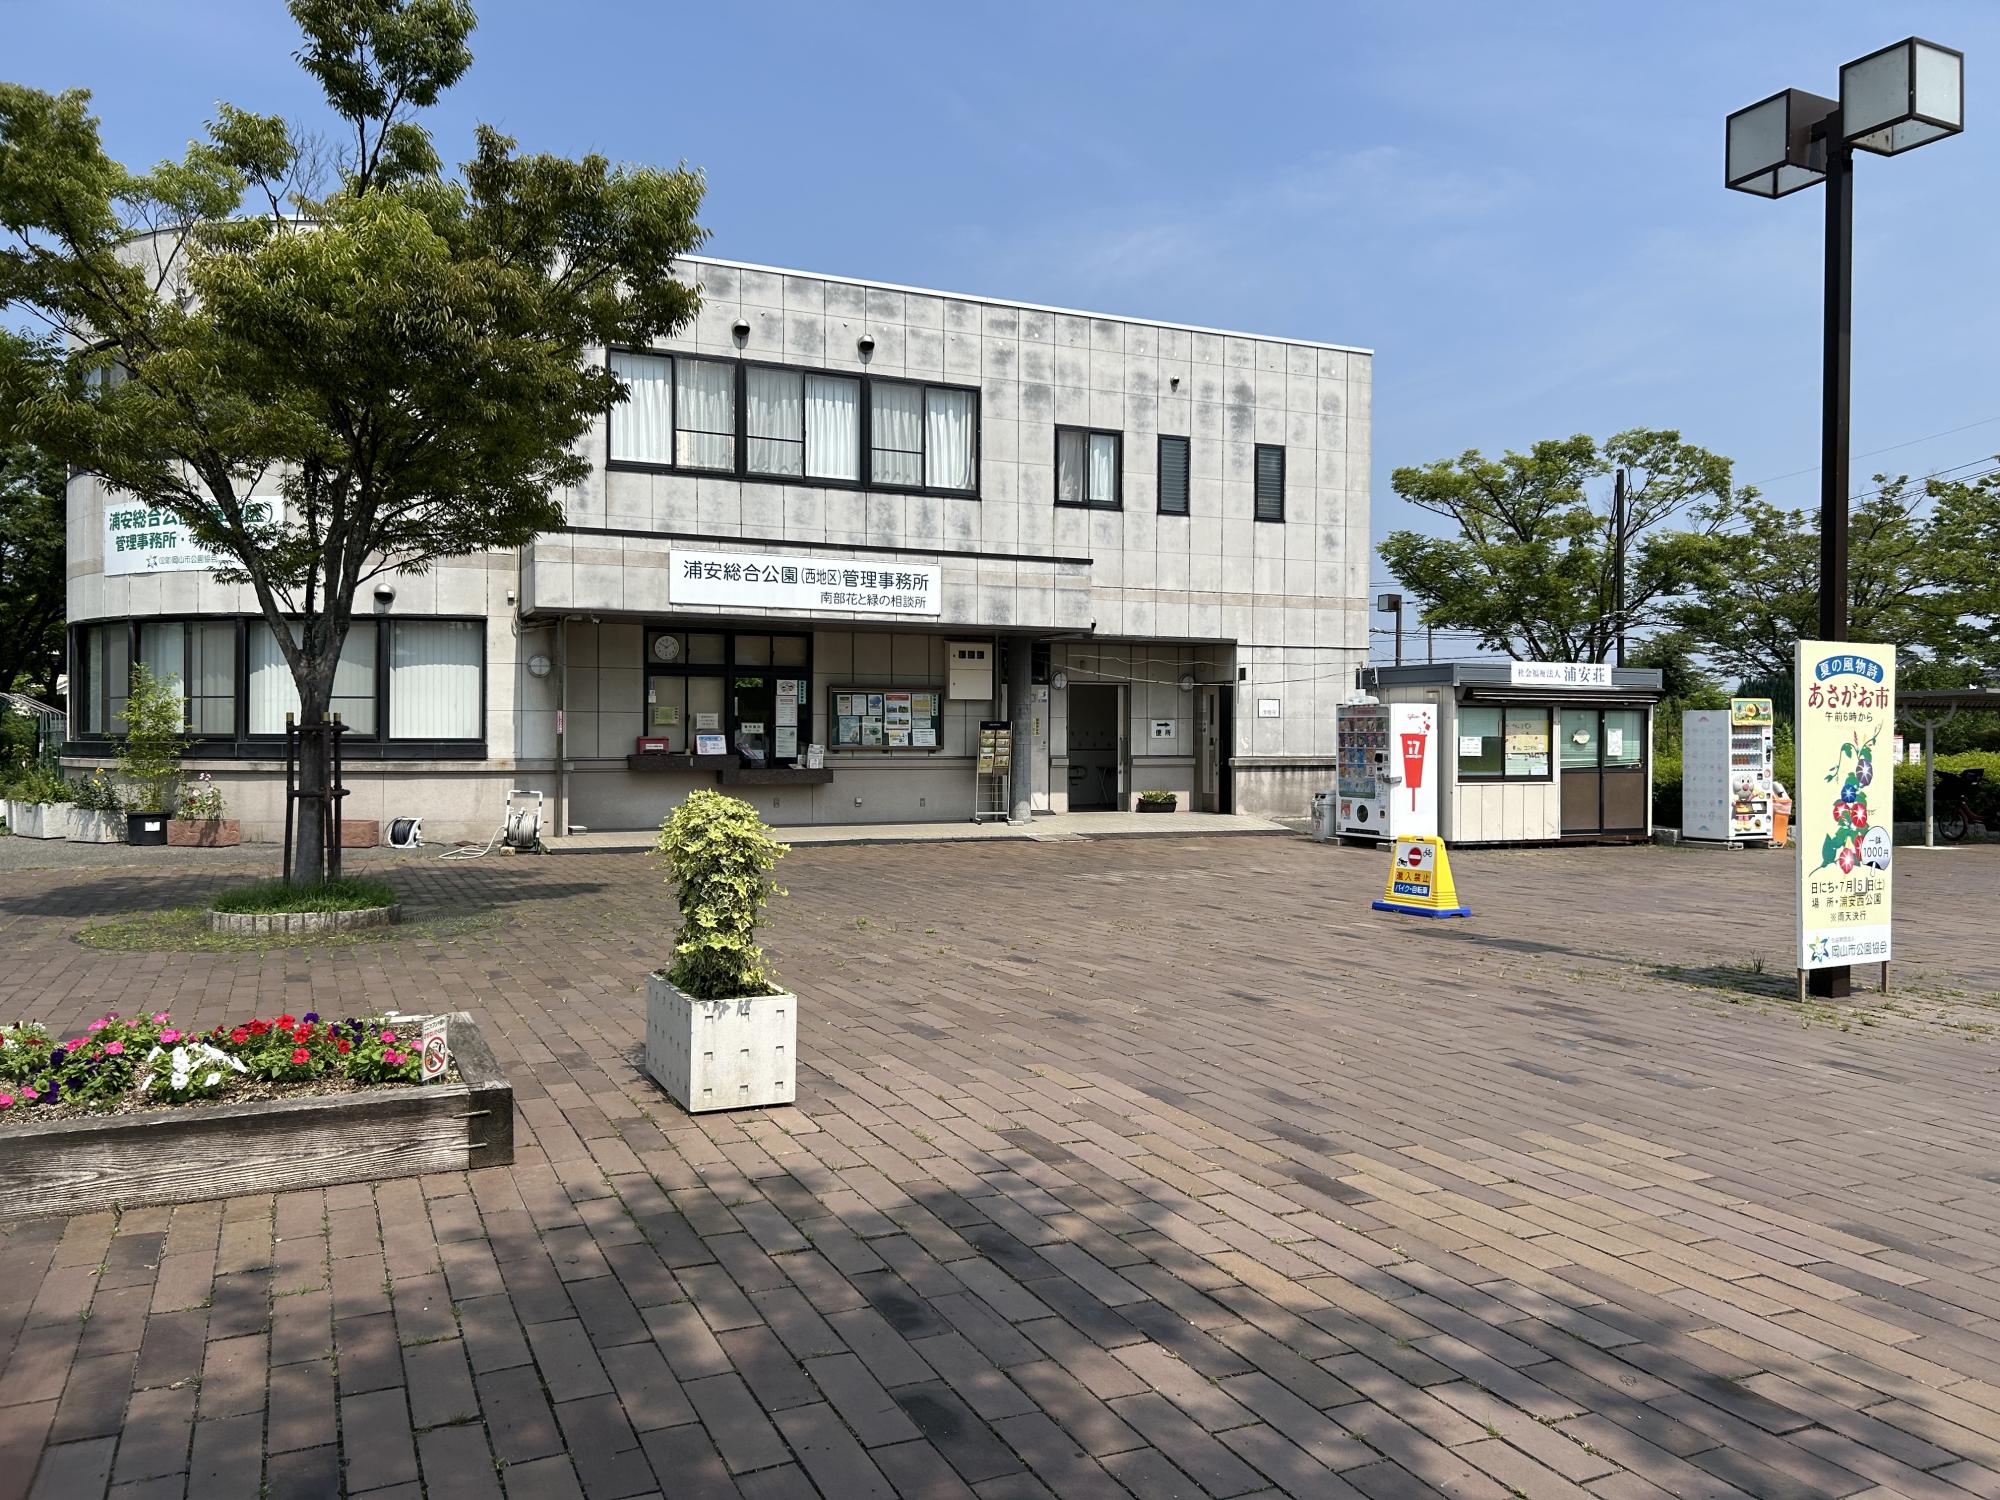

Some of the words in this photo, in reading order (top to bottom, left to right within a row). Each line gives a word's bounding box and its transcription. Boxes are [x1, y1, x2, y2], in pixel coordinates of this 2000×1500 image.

[683, 560, 929, 592] 浦安総合公園(西地区)管理事務所
[820, 591, 926, 609] 南部花と緑の相談所
[1564, 666, 1605, 683] 浦安荘
[1818, 657, 1880, 680] 夏の風物詩
[1808, 682, 1890, 709] あさがお市
[1825, 711, 1873, 723] 午前6時から
[1863, 846, 1889, 858] 1000円
[1396, 871, 1429, 883] 進入禁止
